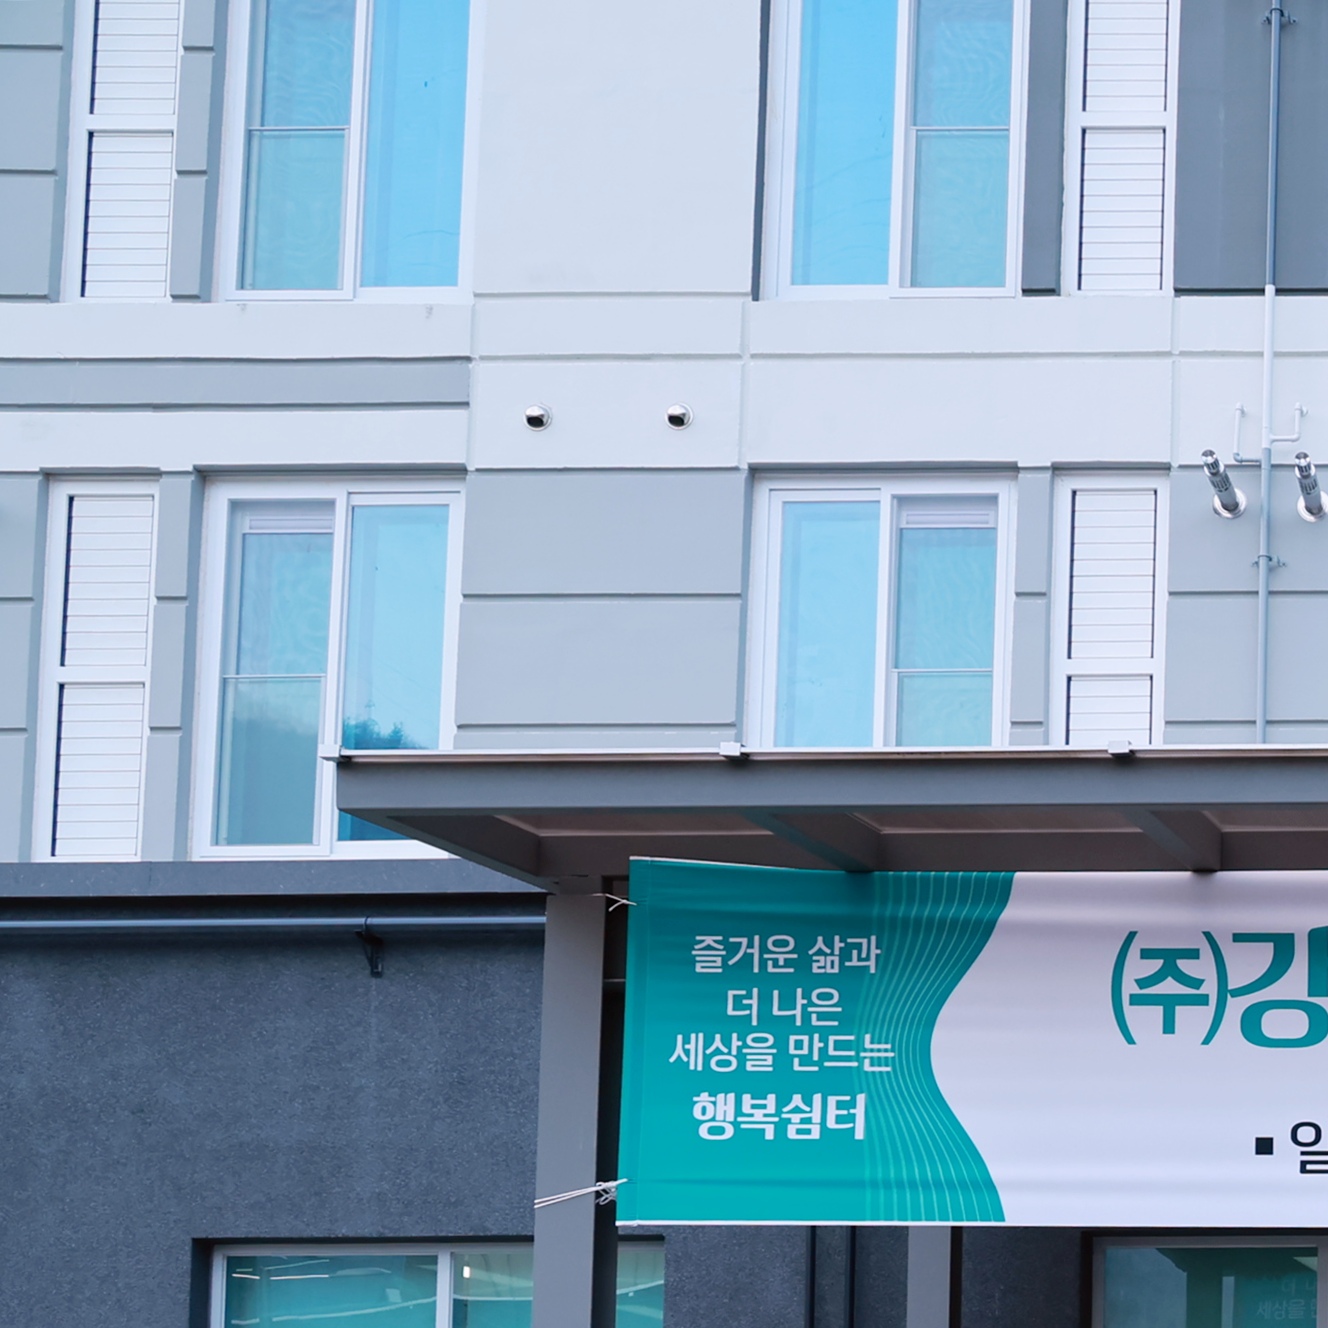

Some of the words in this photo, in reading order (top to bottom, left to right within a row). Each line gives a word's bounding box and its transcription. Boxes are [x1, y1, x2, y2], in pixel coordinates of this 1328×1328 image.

[692, 935, 798, 973] 즐거운
[808, 935, 881, 973] 삶과
[727, 988, 758, 1026] 더
[772, 988, 842, 1026] 나은
[669, 1033, 777, 1072] 세상을
[789, 1033, 895, 1072] 만드는
[693, 1092, 866, 1140] 행복쉼터
